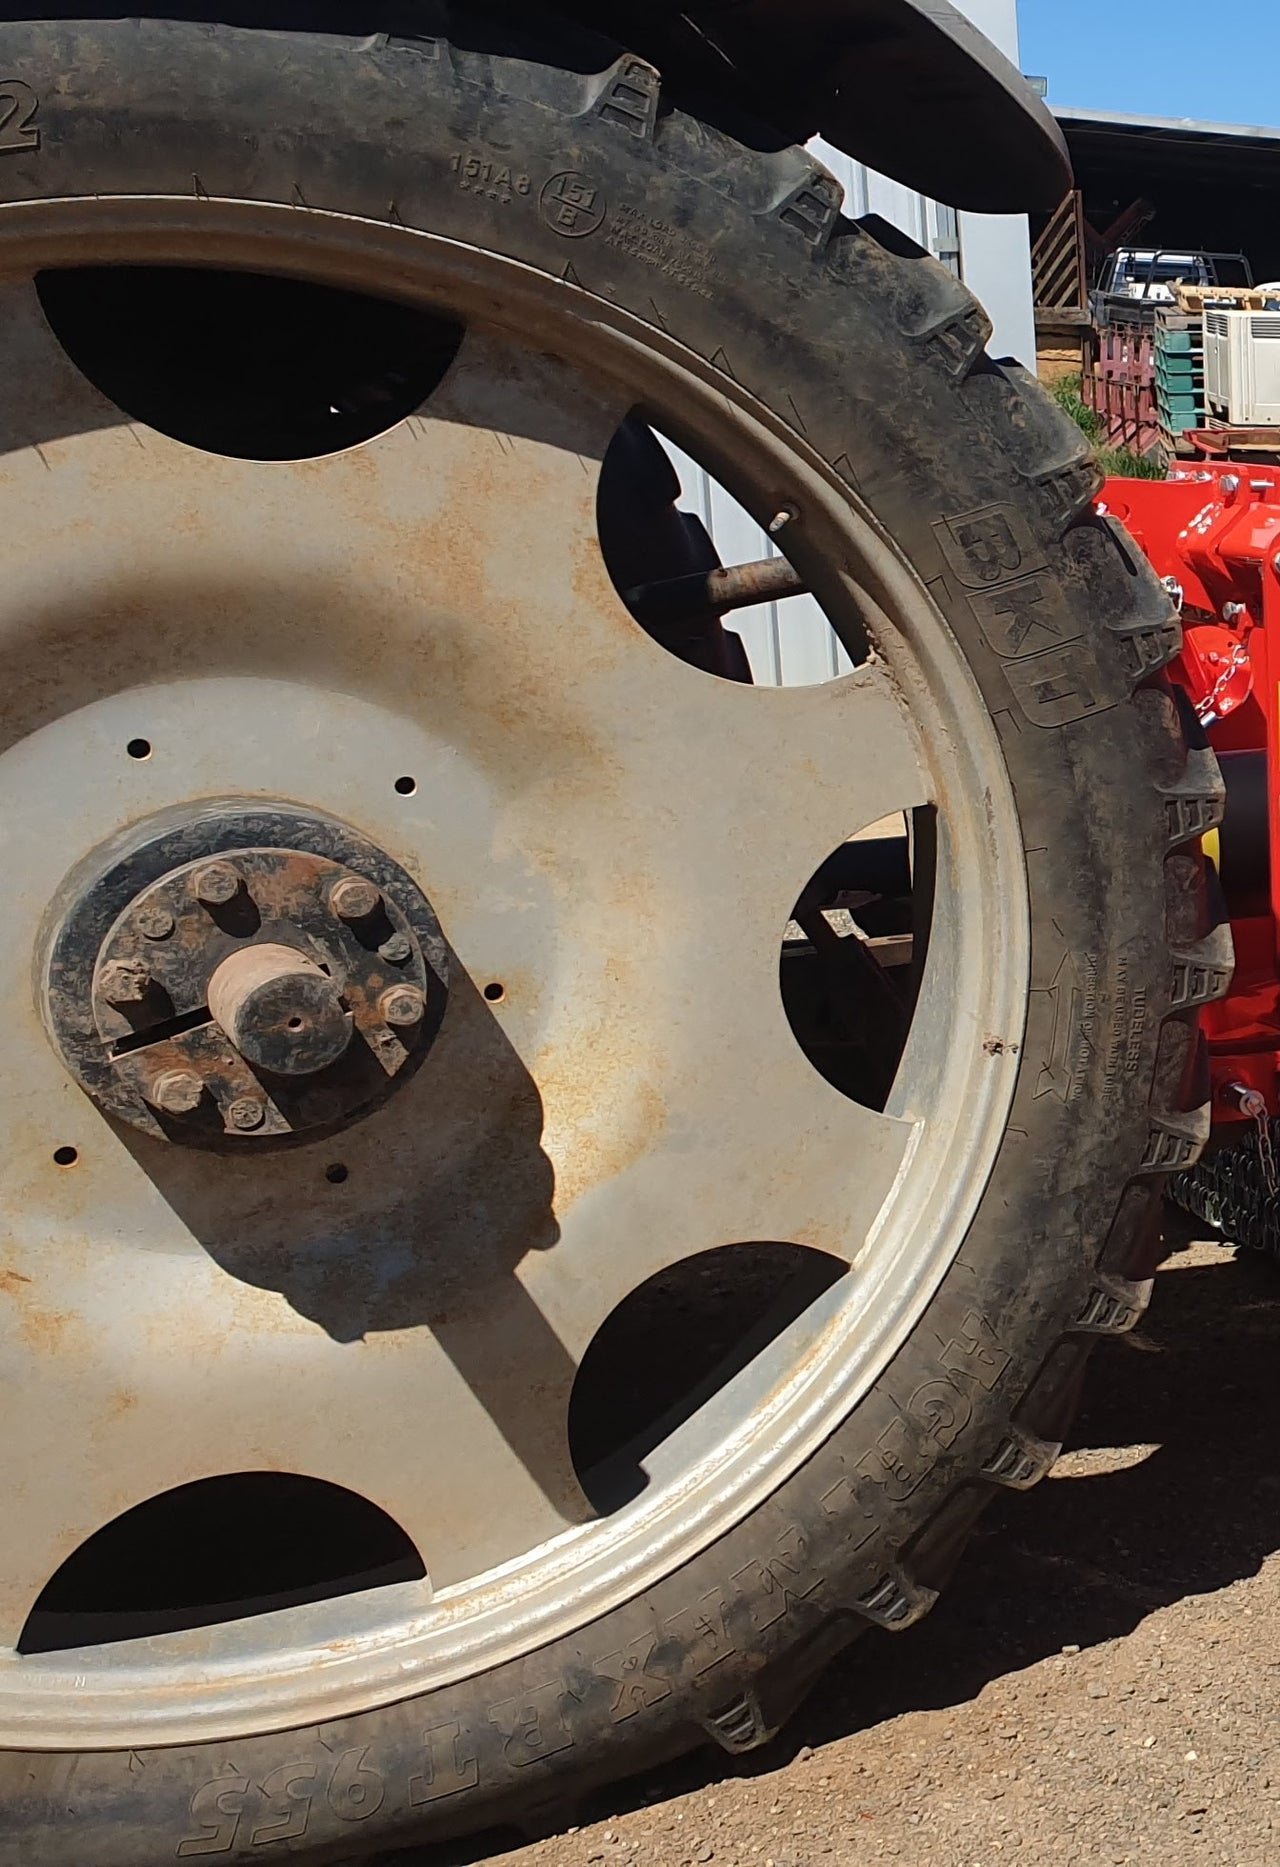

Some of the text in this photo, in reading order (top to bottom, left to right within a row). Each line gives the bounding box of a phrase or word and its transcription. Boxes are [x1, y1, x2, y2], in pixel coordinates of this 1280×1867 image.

[451, 153, 531, 196] 151A8
[556, 176, 598, 210] 151
[557, 205, 579, 227] B
[942, 506, 1106, 718] BKT
[1126, 985, 1147, 1075] TUBELESS
[408, 1680, 576, 1807] RT
[175, 1745, 386, 1858] 955
